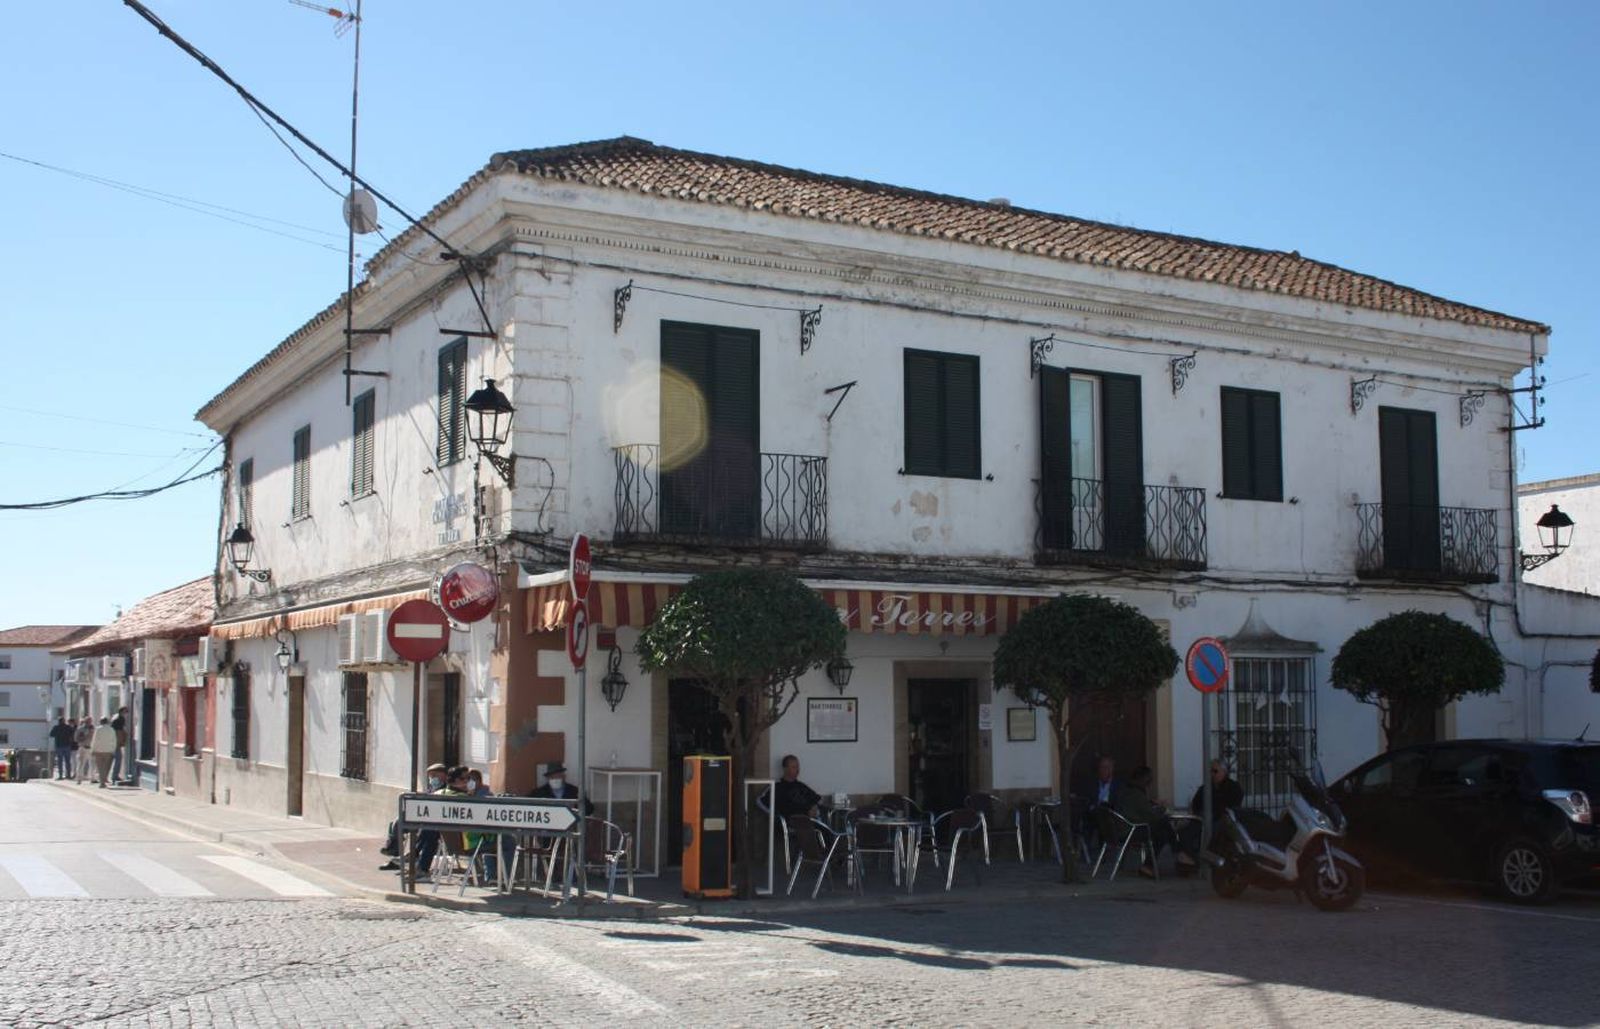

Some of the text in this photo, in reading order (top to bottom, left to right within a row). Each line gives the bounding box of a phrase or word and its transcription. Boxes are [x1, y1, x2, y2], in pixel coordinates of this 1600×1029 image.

[575, 559, 590, 575] STOP
[870, 595, 997, 626] Torres
[416, 805, 551, 824] LA LINEA ALGECIRAS
